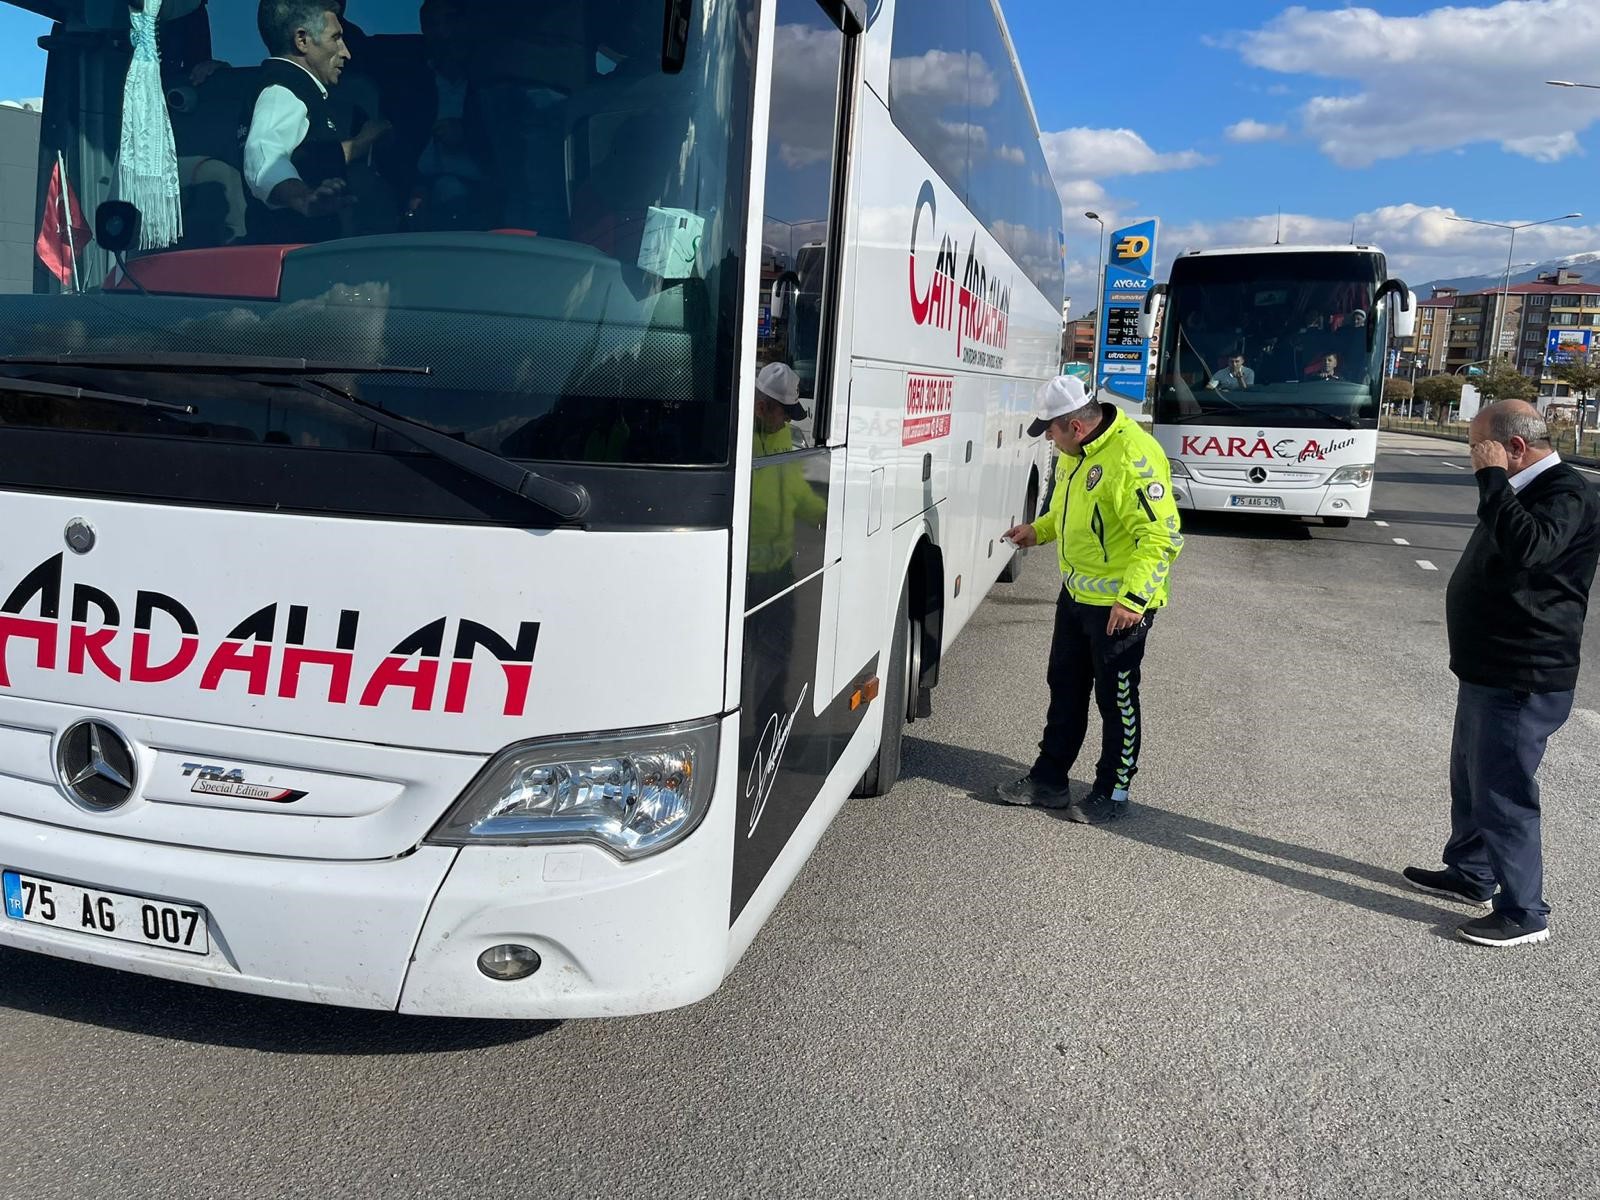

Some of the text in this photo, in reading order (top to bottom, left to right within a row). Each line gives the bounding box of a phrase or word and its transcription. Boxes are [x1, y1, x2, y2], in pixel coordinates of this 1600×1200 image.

[909, 179, 1010, 358] CAN ARDAHAN
[1113, 280, 1147, 288] AYGAZ
[0, 552, 540, 716] ARDAHAN
[181, 762, 245, 783] TRA
[200, 781, 269, 797] Special Edition
[11, 898, 21, 909] TR
[22, 880, 199, 946] 75 AG 007
